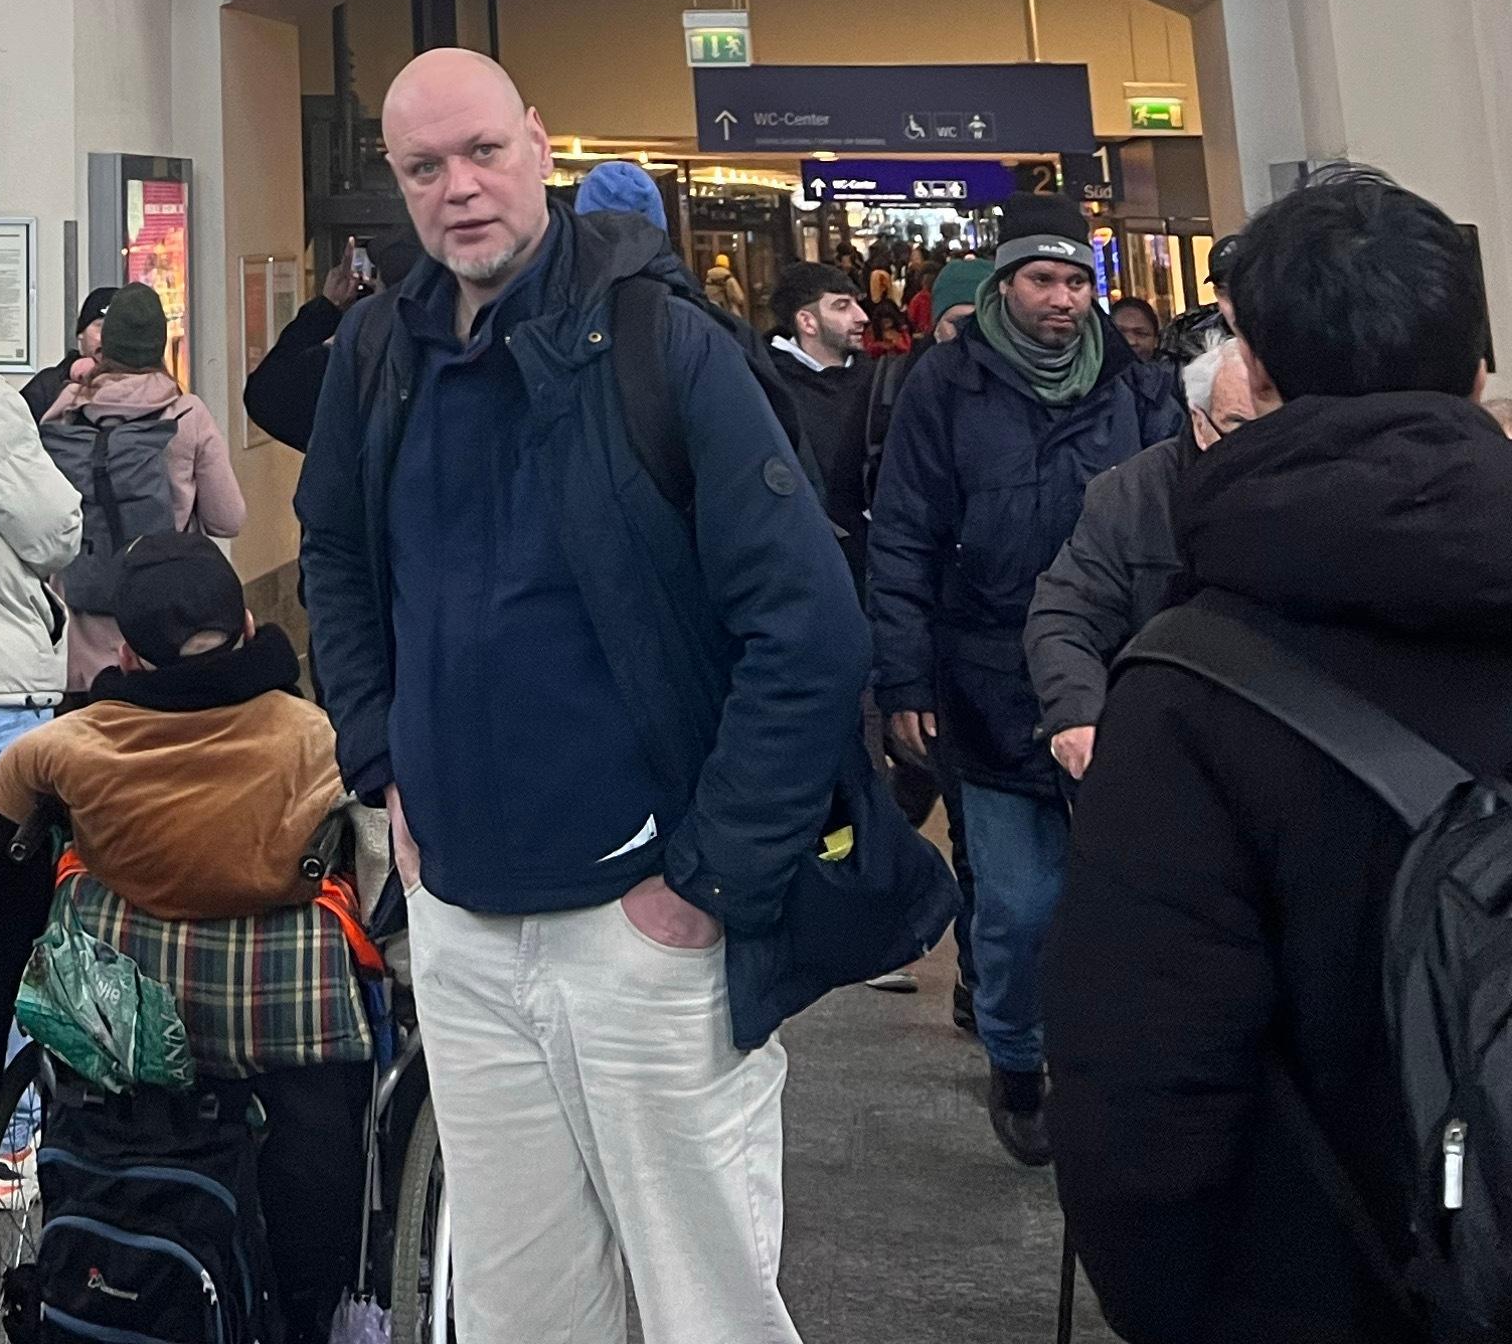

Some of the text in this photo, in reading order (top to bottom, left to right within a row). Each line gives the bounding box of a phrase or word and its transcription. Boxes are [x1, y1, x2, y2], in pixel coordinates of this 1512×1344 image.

[753, 112, 830, 126] WC-Center
[936, 125, 957, 138] WC
[1092, 146, 1110, 183] 1
[1032, 165, 1054, 196] 2
[1084, 184, 1113, 200] Süd
